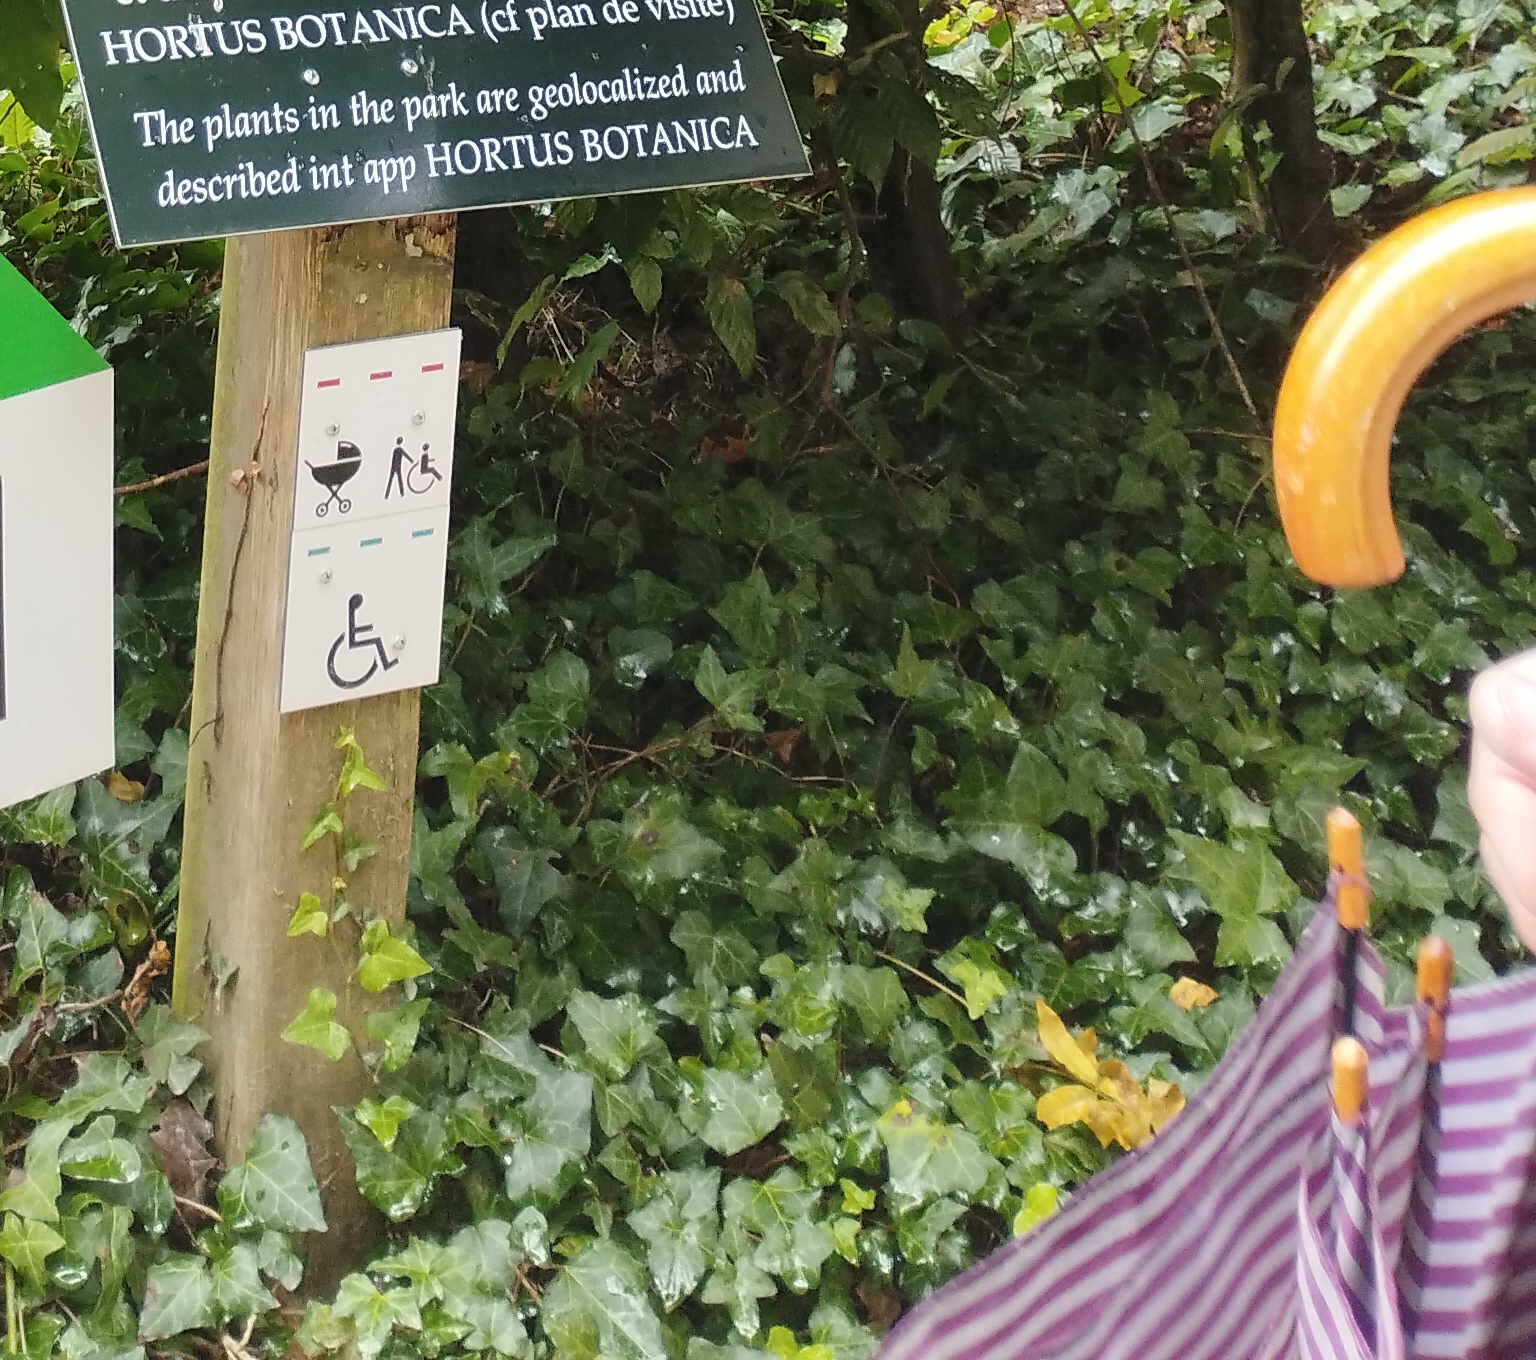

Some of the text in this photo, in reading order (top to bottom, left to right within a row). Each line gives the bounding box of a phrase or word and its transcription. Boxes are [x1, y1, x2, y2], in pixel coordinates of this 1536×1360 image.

[100, 18, 267, 66] HORTUS
[270, 3, 476, 51] BOTANICA
[133, 59, 747, 152] The plants in the park are geolocalized and
[158, 114, 760, 208] described int app HORTUS BOTANICA
